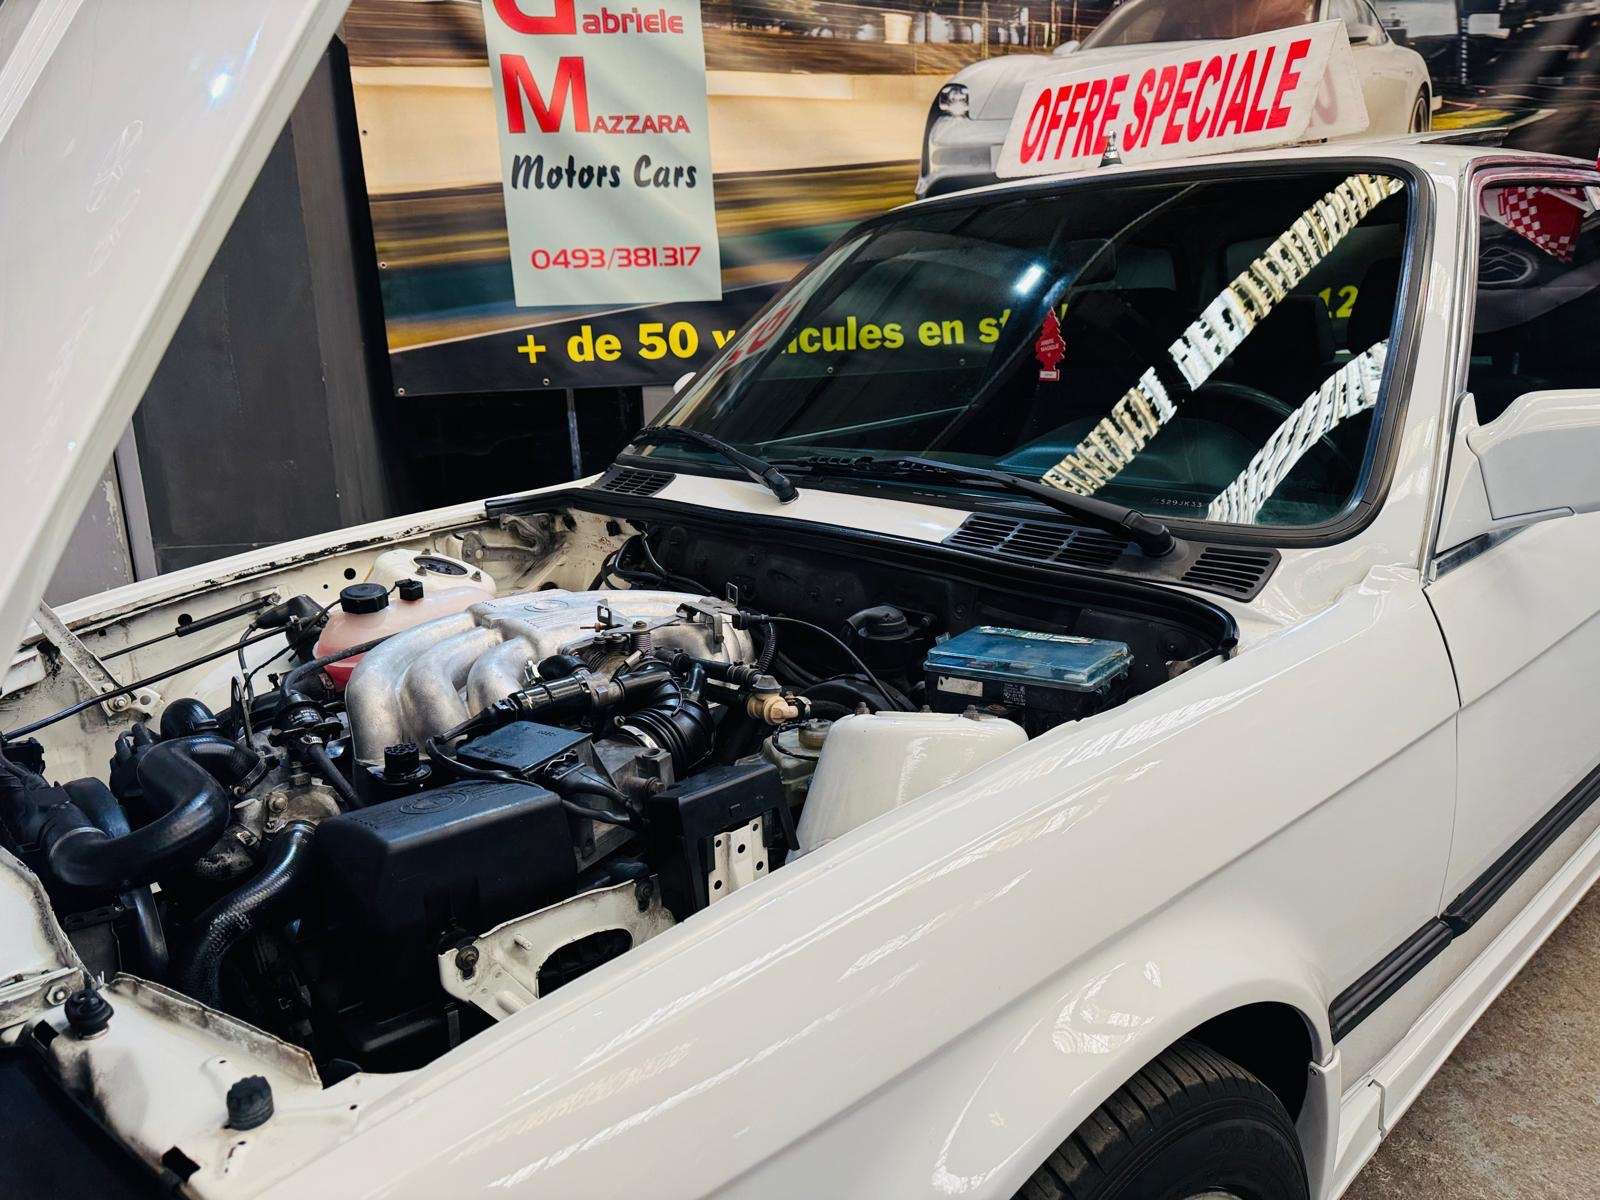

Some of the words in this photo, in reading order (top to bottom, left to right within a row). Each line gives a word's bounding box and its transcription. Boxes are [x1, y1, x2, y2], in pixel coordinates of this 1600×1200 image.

[499, 53, 691, 134] MAZZARA
[1019, 73, 1131, 165] OFFRE
[1123, 38, 1312, 152] SPECIALE
[511, 154, 621, 189] Motors
[633, 154, 697, 188] Cars
[531, 246, 702, 270] 0493/381.317
[567, 325, 622, 362] de
[638, 321, 699, 360] 50
[917, 319, 966, 346] en
